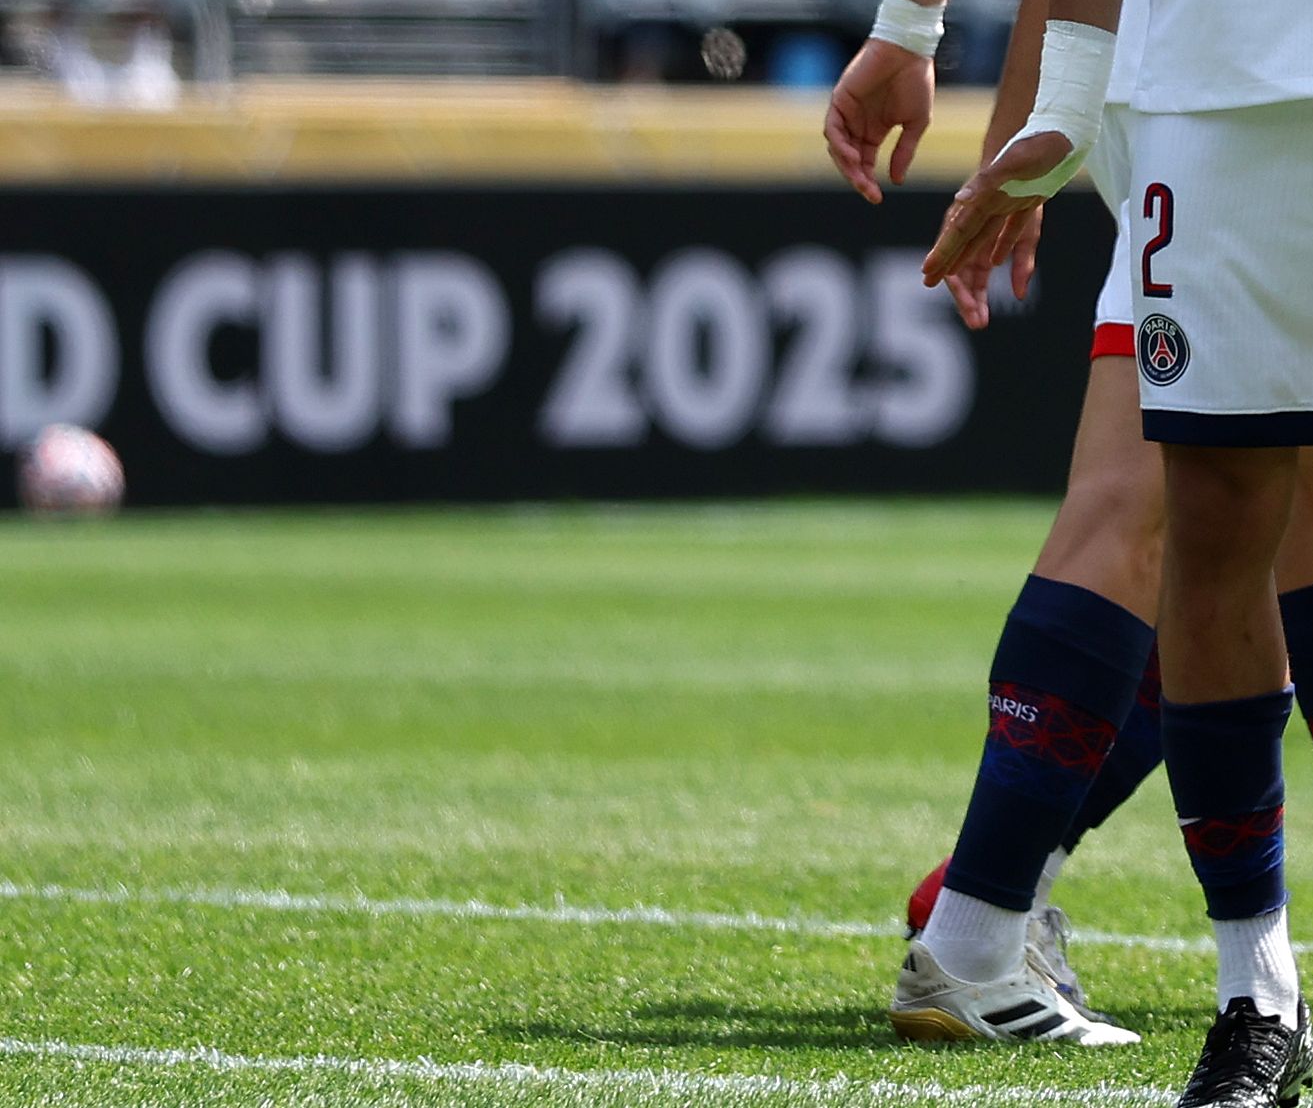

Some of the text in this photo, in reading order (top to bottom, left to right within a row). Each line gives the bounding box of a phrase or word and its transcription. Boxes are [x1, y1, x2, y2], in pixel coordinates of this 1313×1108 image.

[1141, 182, 1174, 299] 2
[146, 250, 510, 454] CUP
[535, 247, 974, 448] 2025
[1145, 319, 1177, 336] PARIS
